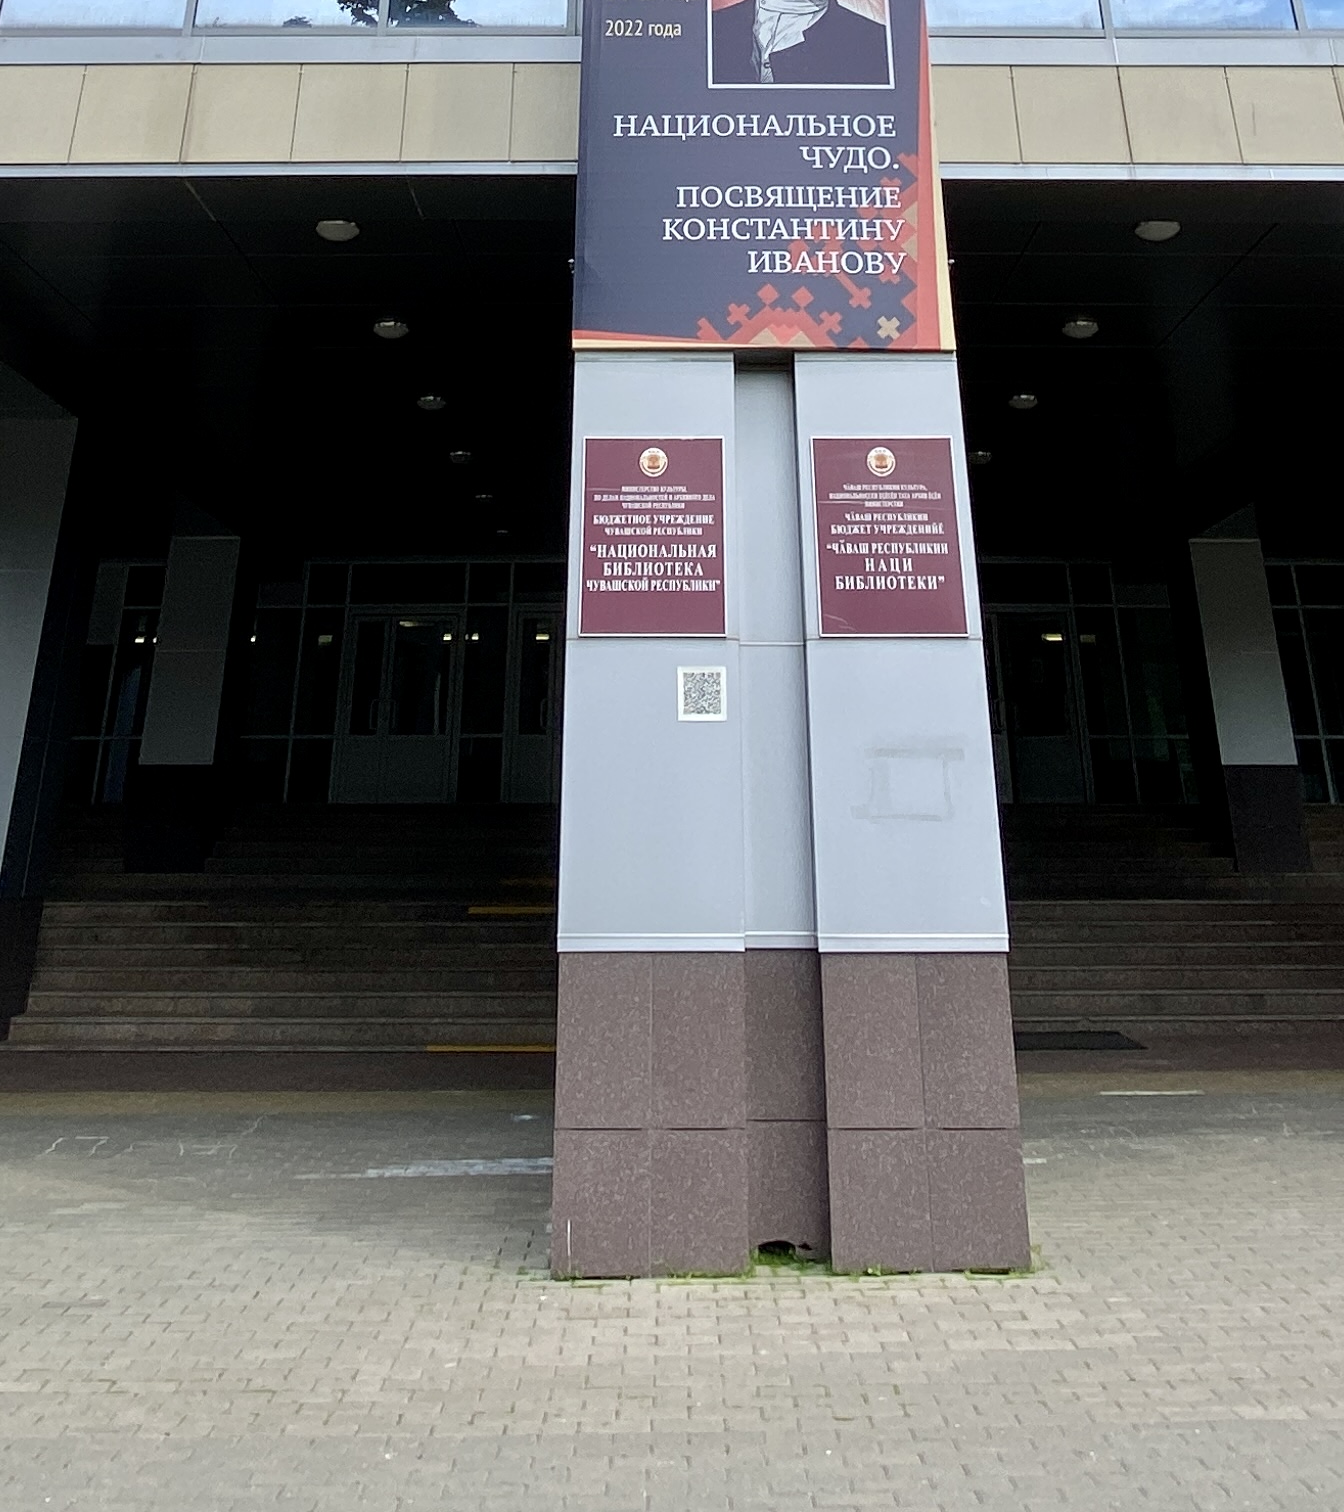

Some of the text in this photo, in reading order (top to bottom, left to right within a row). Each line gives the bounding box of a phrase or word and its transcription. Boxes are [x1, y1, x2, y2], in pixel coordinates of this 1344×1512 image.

[605, 19, 682, 39] 2022 года
[613, 114, 896, 140] НАЦИОНАЛЬНОЕ
[799, 146, 900, 173] ЧУДО.
[676, 186, 902, 211] ПОСВЯЩЕНИЕ
[662, 218, 906, 241] КОНСТАНТИНУ
[747, 250, 907, 274] ИВАНОВУ
[593, 514, 715, 525] БЮДЖЕТНОЕ УЧРЕЖДЕНИЕ
[830, 524, 871, 535] БЮДЖЕТ
[871, 542, 949, 555] РЕСПУБЛИКИН
[603, 561, 704, 576] БИБЛИОТЕКА
[586, 577, 649, 592] ЧУВАШСКОЙ
